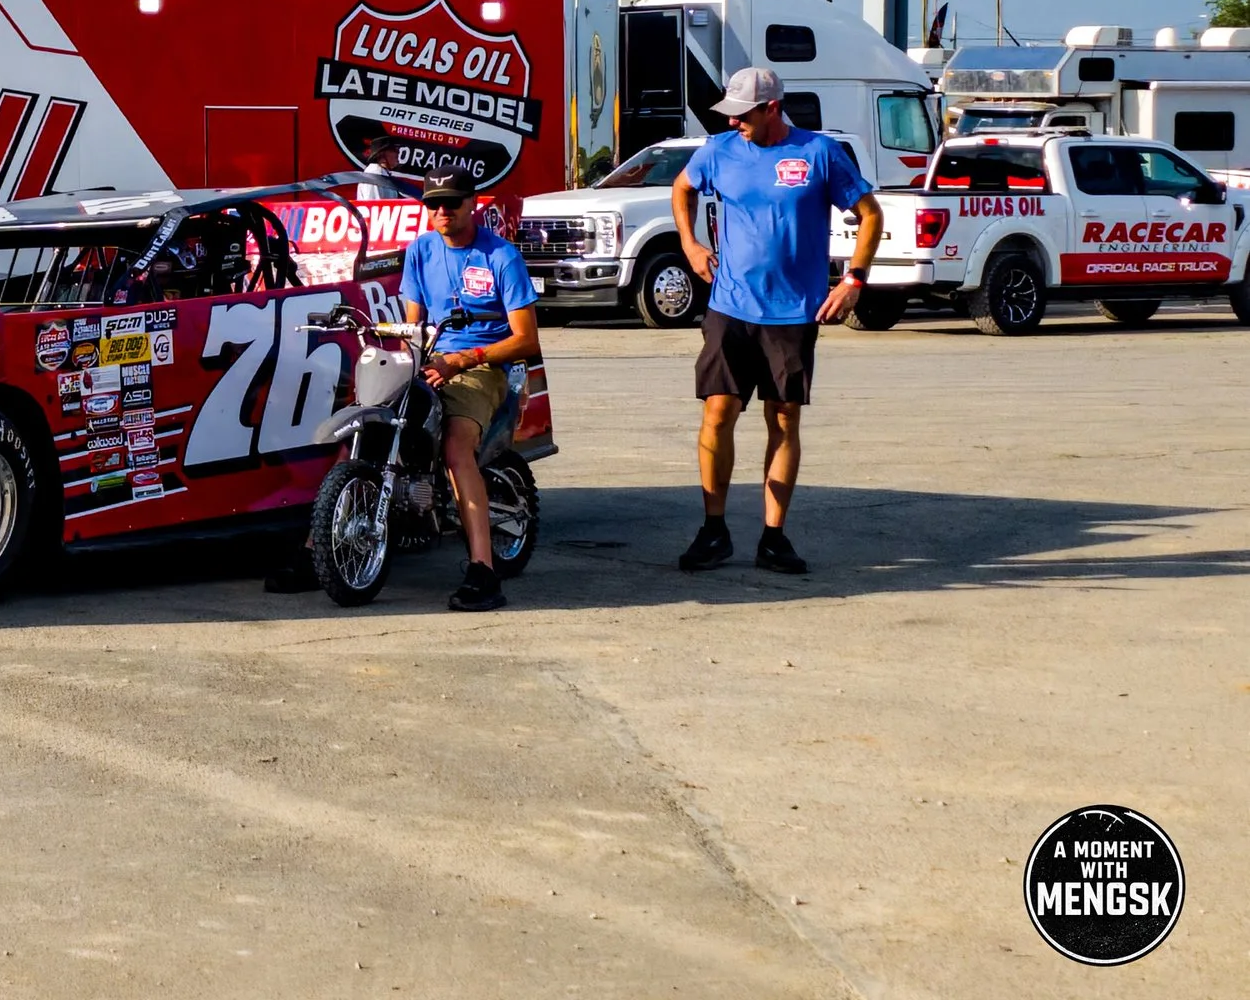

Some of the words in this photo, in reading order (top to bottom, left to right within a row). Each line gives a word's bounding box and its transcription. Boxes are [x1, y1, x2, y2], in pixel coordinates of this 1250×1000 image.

[352, 24, 458, 74] LUCAS
[463, 46, 511, 85] OIL
[321, 64, 408, 100] LATE
[415, 81, 534, 132] MODEL
[380, 106, 415, 121] DIRT
[418, 113, 474, 132] SERIES
[391, 125, 444, 142] PRESENTED
[448, 136, 461, 145] BY
[959, 197, 1014, 217] LUCAS
[1018, 197, 1045, 217] OIL
[302, 205, 432, 243] BOSWEL
[1082, 222, 1226, 243] RACECAR
[1099, 243, 1211, 253] ENGINEERING
[1086, 262, 1140, 274] OFFICIAL
[1142, 262, 1176, 273] RACE
[1178, 261, 1219, 272] TRUCK
[146, 309, 176, 324] DUDE
[153, 342, 170, 353] VG
[122, 364, 150, 377] MUSCLE
[184, 291, 343, 468] 76
